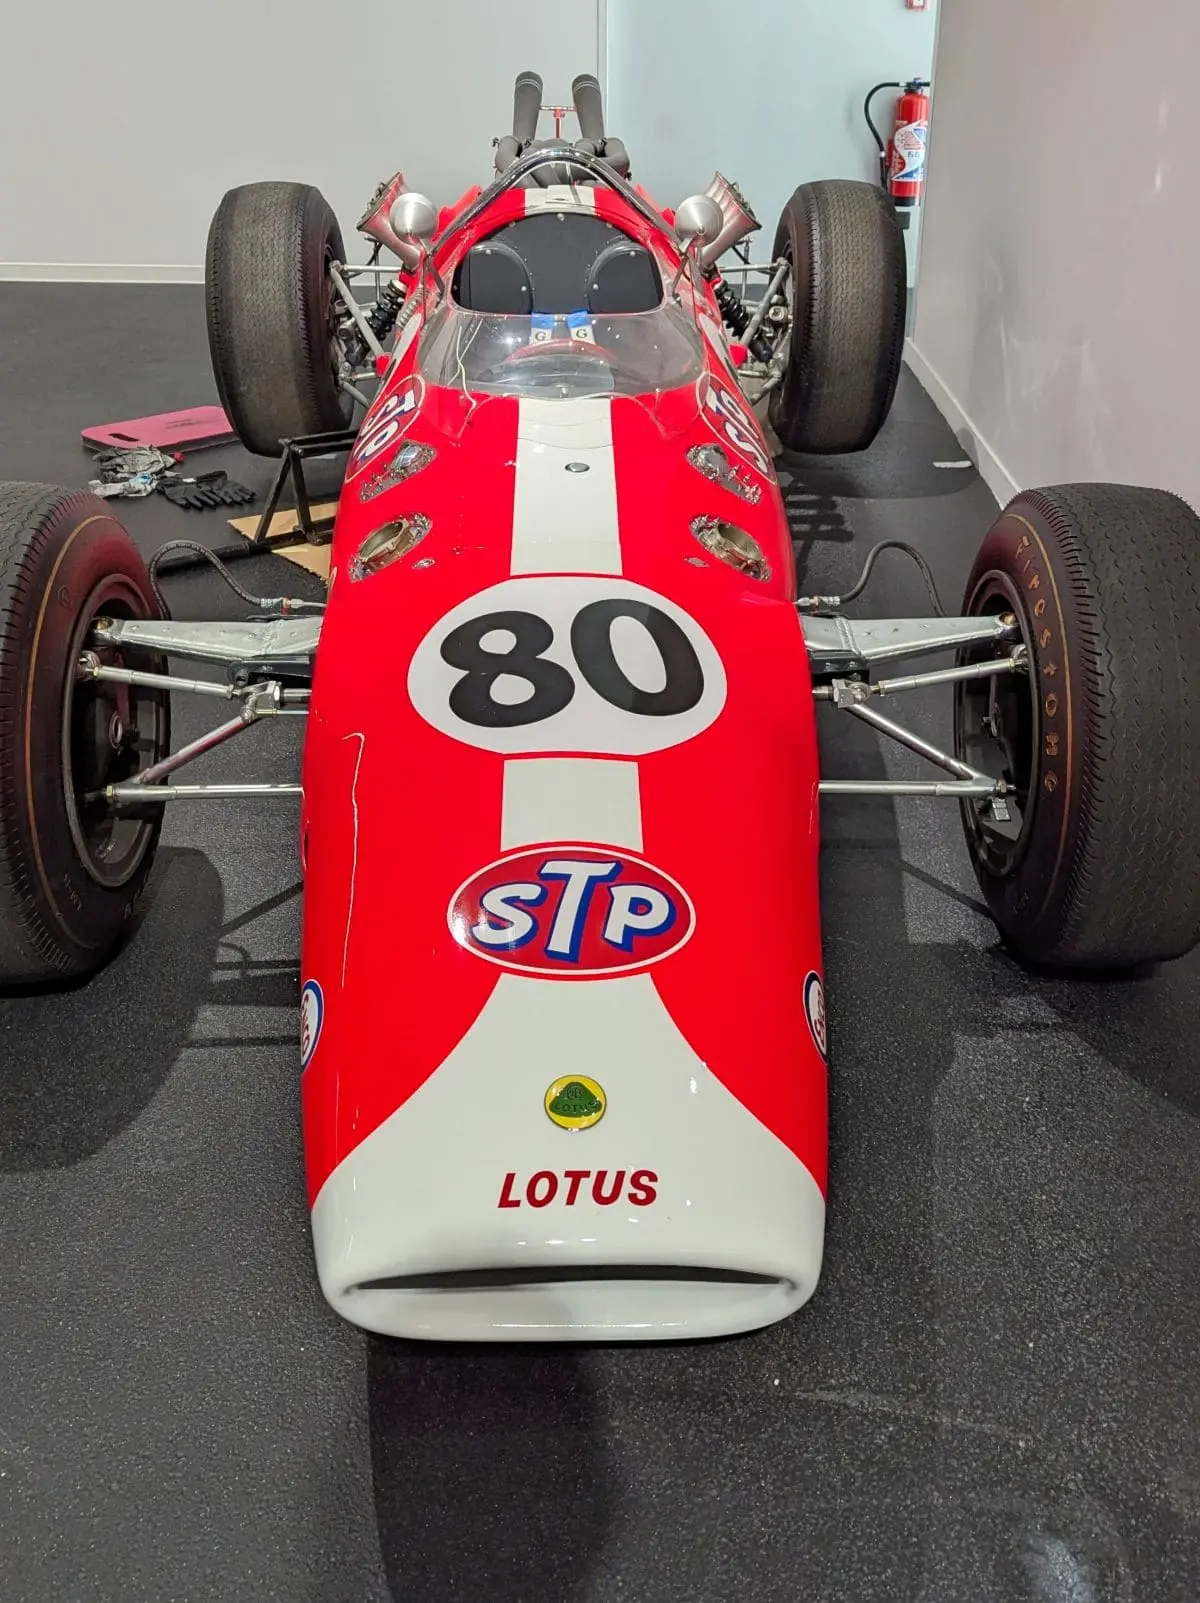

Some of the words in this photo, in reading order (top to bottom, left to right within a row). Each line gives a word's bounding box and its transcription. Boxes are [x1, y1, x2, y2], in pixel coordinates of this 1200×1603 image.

[440, 598, 705, 729] 80
[470, 858, 677, 964] STP
[497, 1169, 659, 1209] LOTUS
